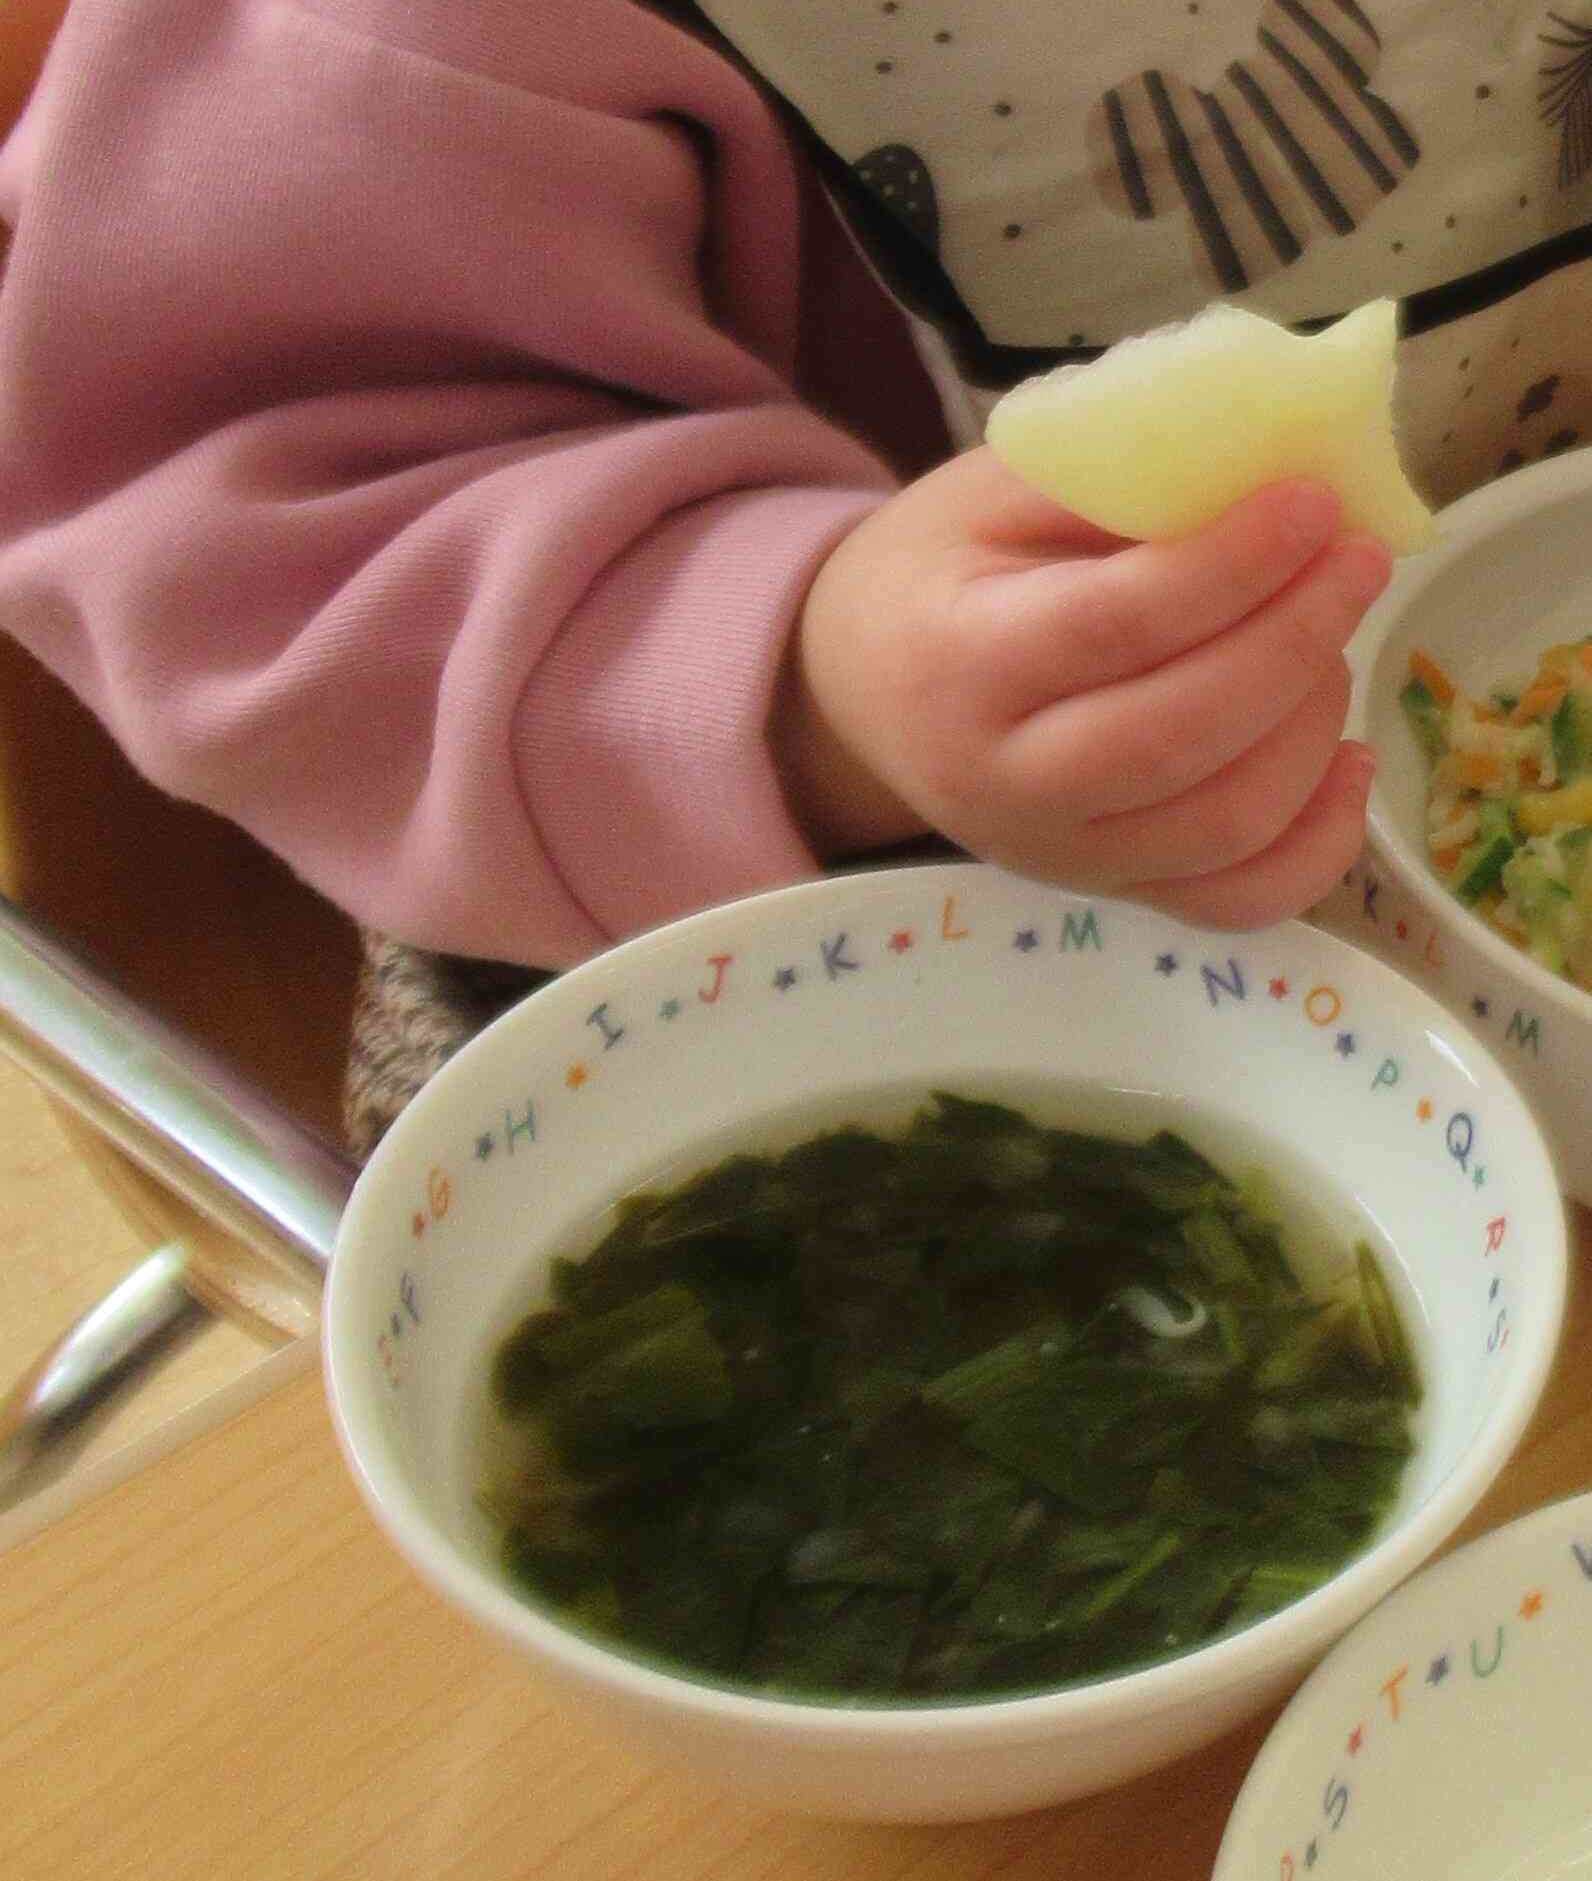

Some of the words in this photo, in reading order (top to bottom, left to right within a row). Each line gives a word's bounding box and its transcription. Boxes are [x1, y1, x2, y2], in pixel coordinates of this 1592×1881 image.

[428, 1167, 451, 1222] G
[505, 1099, 536, 1156] H
[587, 1002, 624, 1050] I
[698, 954, 732, 1004] J
[819, 931, 861, 981] K
[941, 896, 969, 942] L
[1059, 907, 1102, 954] M
[1201, 958, 1248, 1007] N
[1303, 984, 1343, 1026] O
[1371, 1057, 1400, 1091] P
[1446, 1113, 1474, 1172] Q
[1505, 1008, 1542, 1058] M
[1323, 1775, 1348, 1832] S
[1379, 1664, 1409, 1720] T
[1470, 1625, 1505, 1679] U
